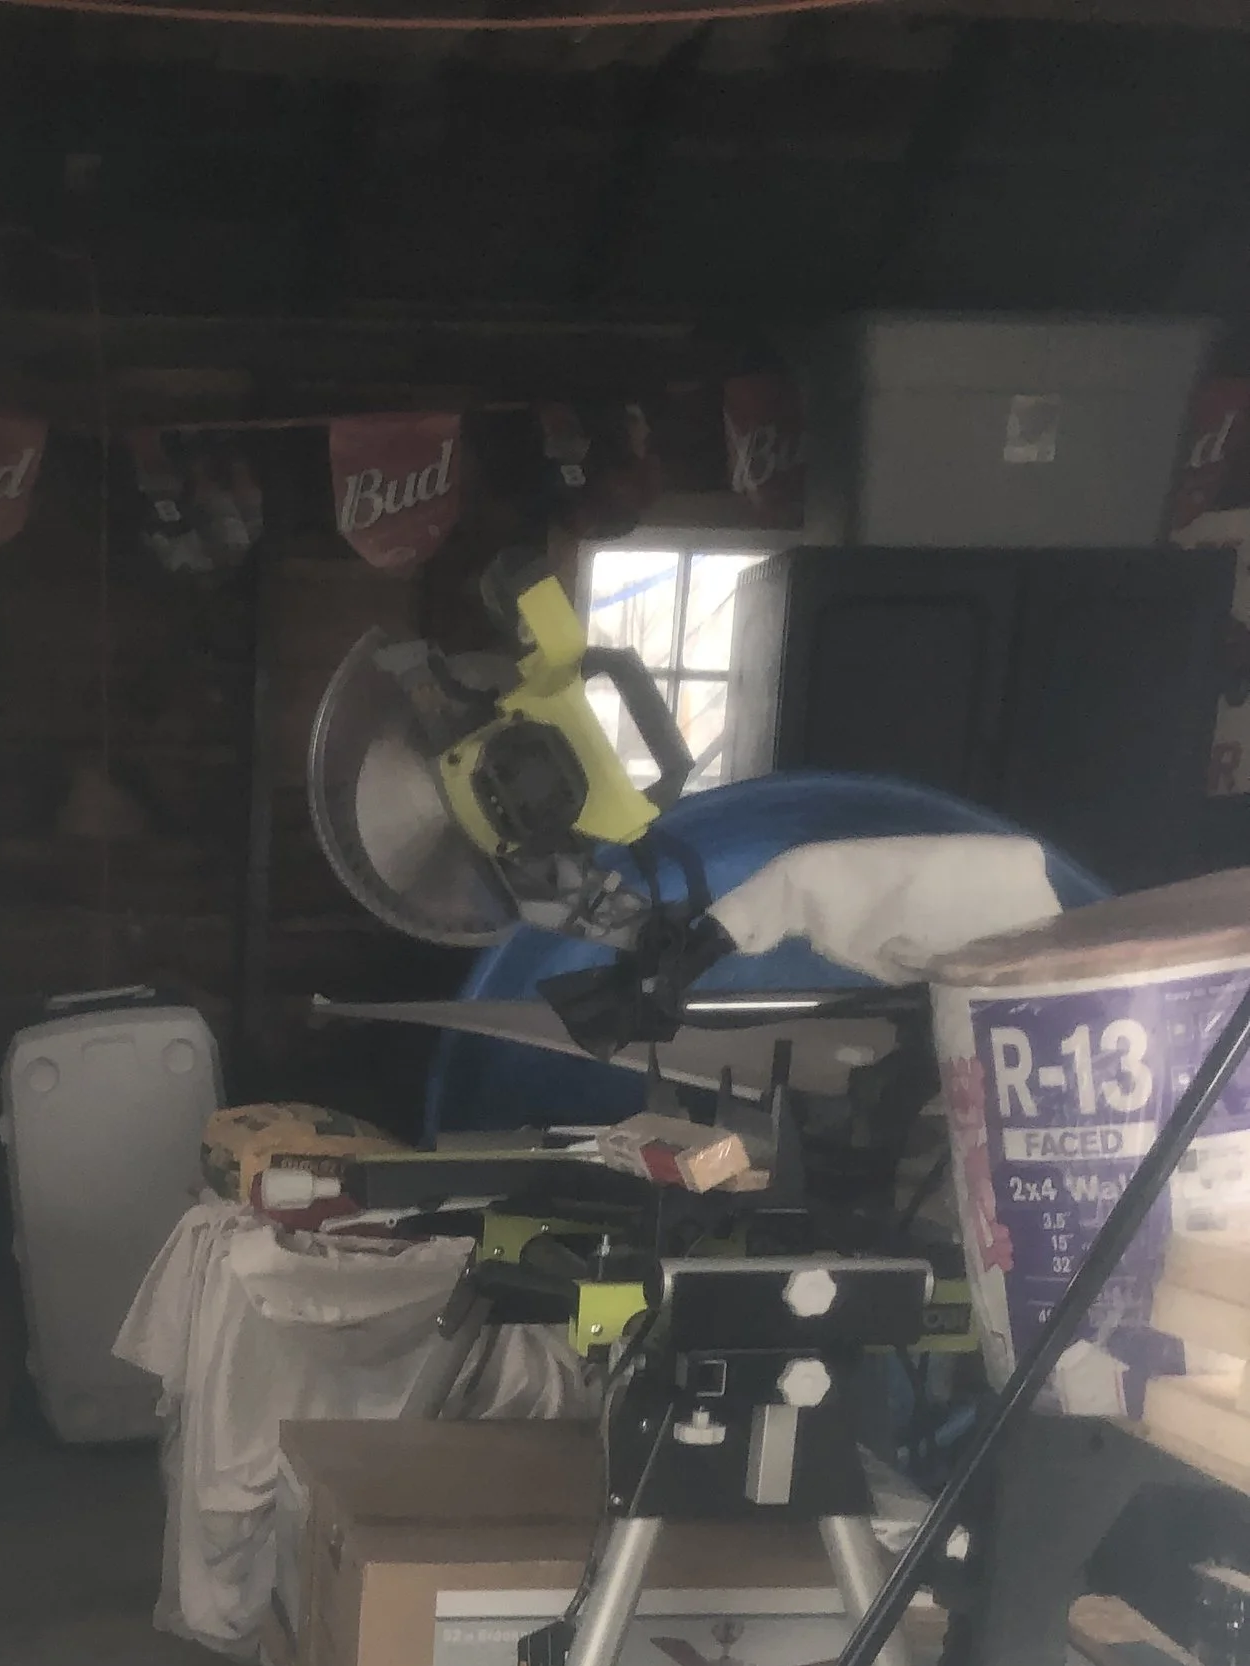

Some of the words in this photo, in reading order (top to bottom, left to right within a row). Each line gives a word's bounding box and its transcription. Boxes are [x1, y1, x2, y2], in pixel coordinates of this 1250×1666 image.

[338, 439, 454, 533] Bud
[990, 1019, 1152, 1117] R-13
[1025, 1129, 1123, 1157] FACED
[1009, 1176, 1058, 1201] 2x4
